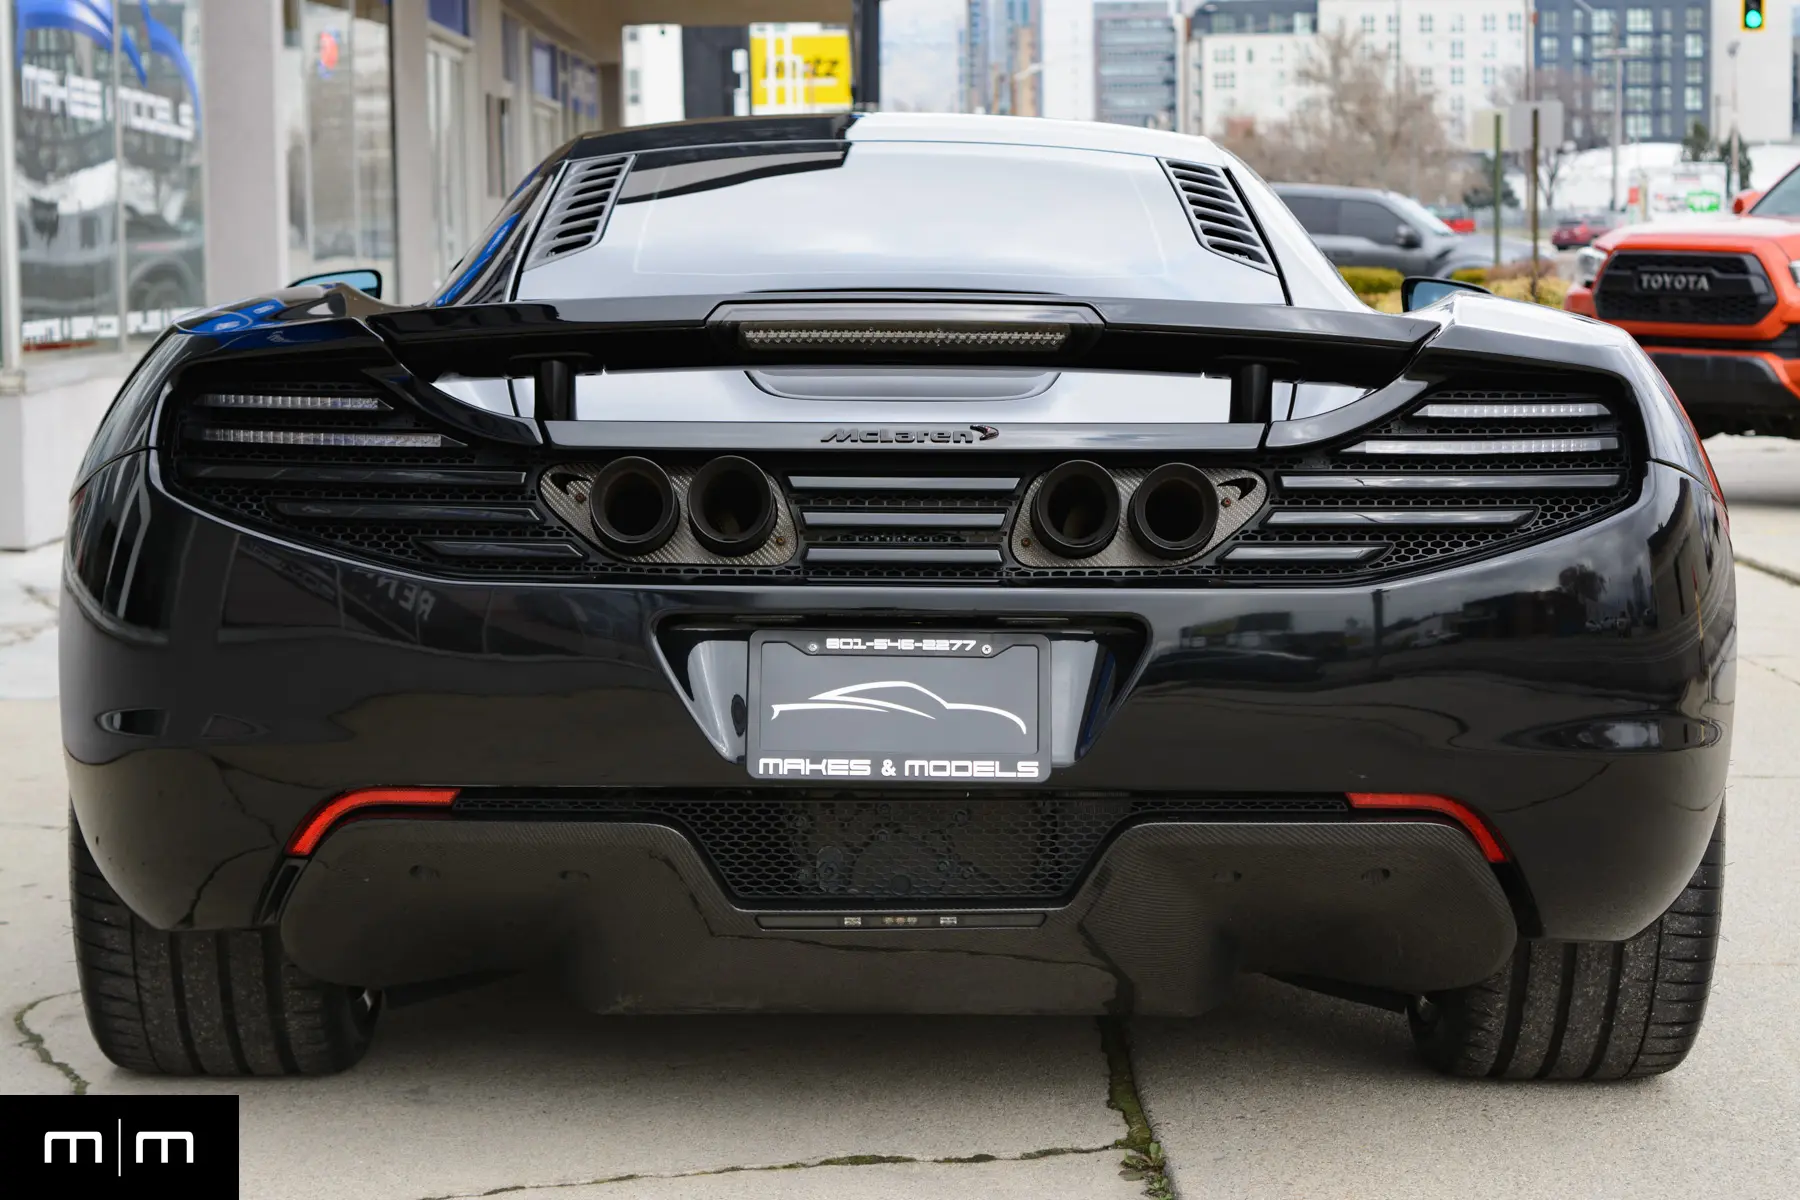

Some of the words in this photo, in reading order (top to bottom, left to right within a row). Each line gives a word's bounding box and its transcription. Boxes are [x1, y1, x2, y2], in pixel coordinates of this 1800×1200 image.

[1641, 272, 1709, 291] TOYOTA
[820, 427, 974, 443] McLaren
[826, 637, 977, 651] 801-546-2277
[758, 757, 872, 776] MAKES
[881, 759, 897, 776] &
[904, 760, 1039, 778] MODELS
